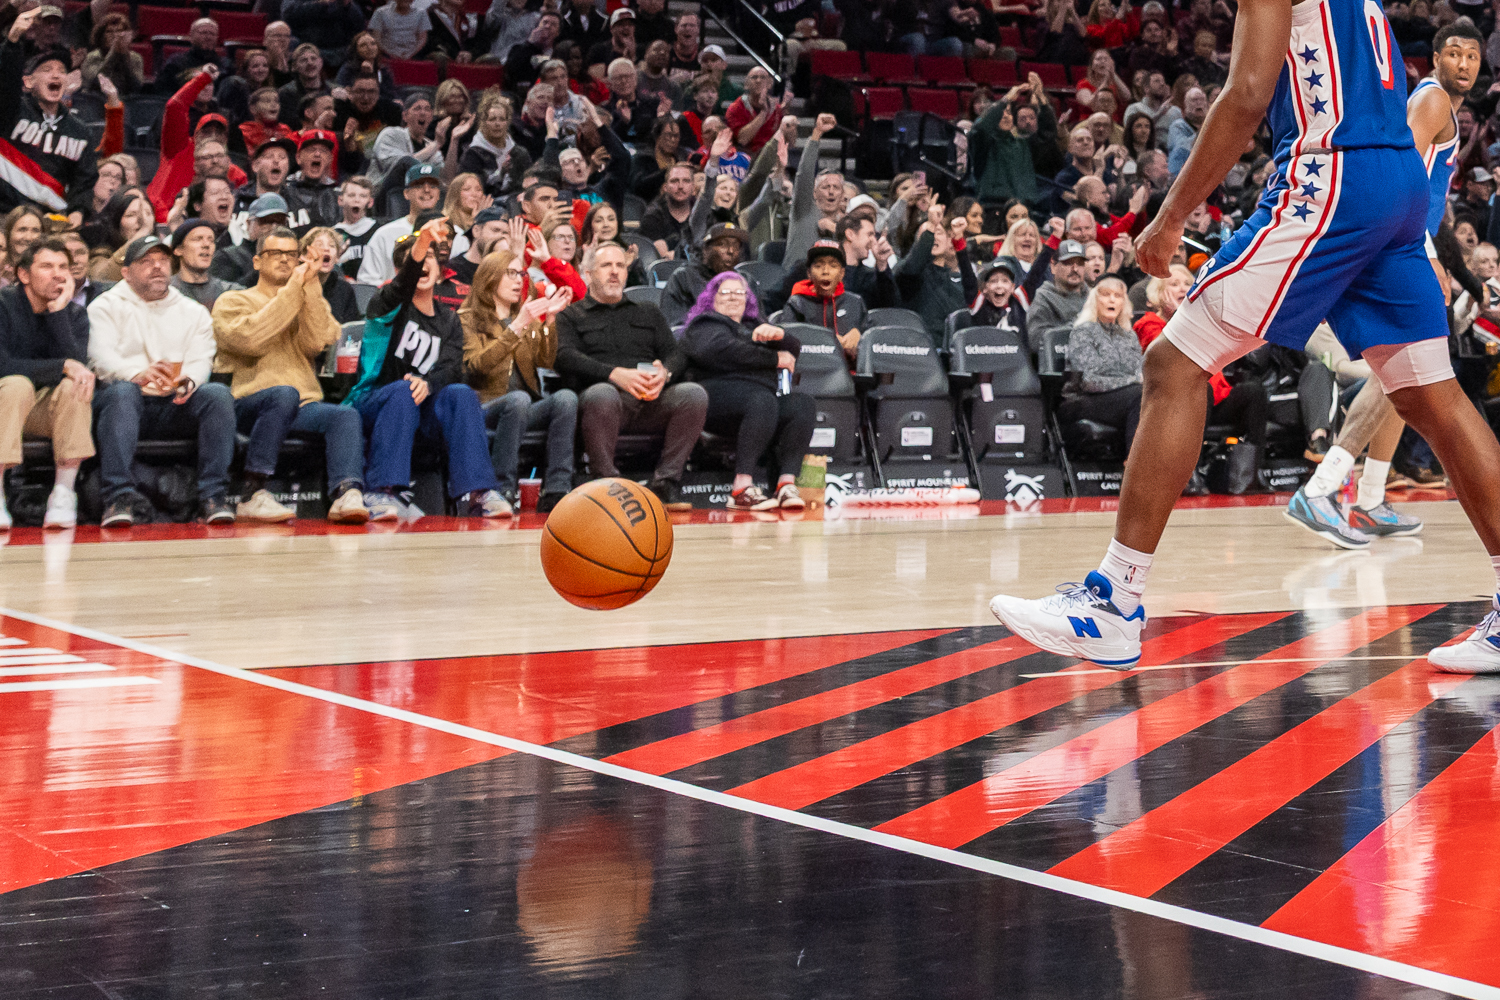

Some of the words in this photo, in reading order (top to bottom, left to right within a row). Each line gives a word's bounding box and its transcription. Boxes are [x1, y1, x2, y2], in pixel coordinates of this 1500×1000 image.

[872, 343, 930, 357] ticketmaster
[965, 344, 1019, 355] ticketmaster
[887, 478, 916, 488] SPIRIT
[682, 484, 712, 495] SPIRIT
